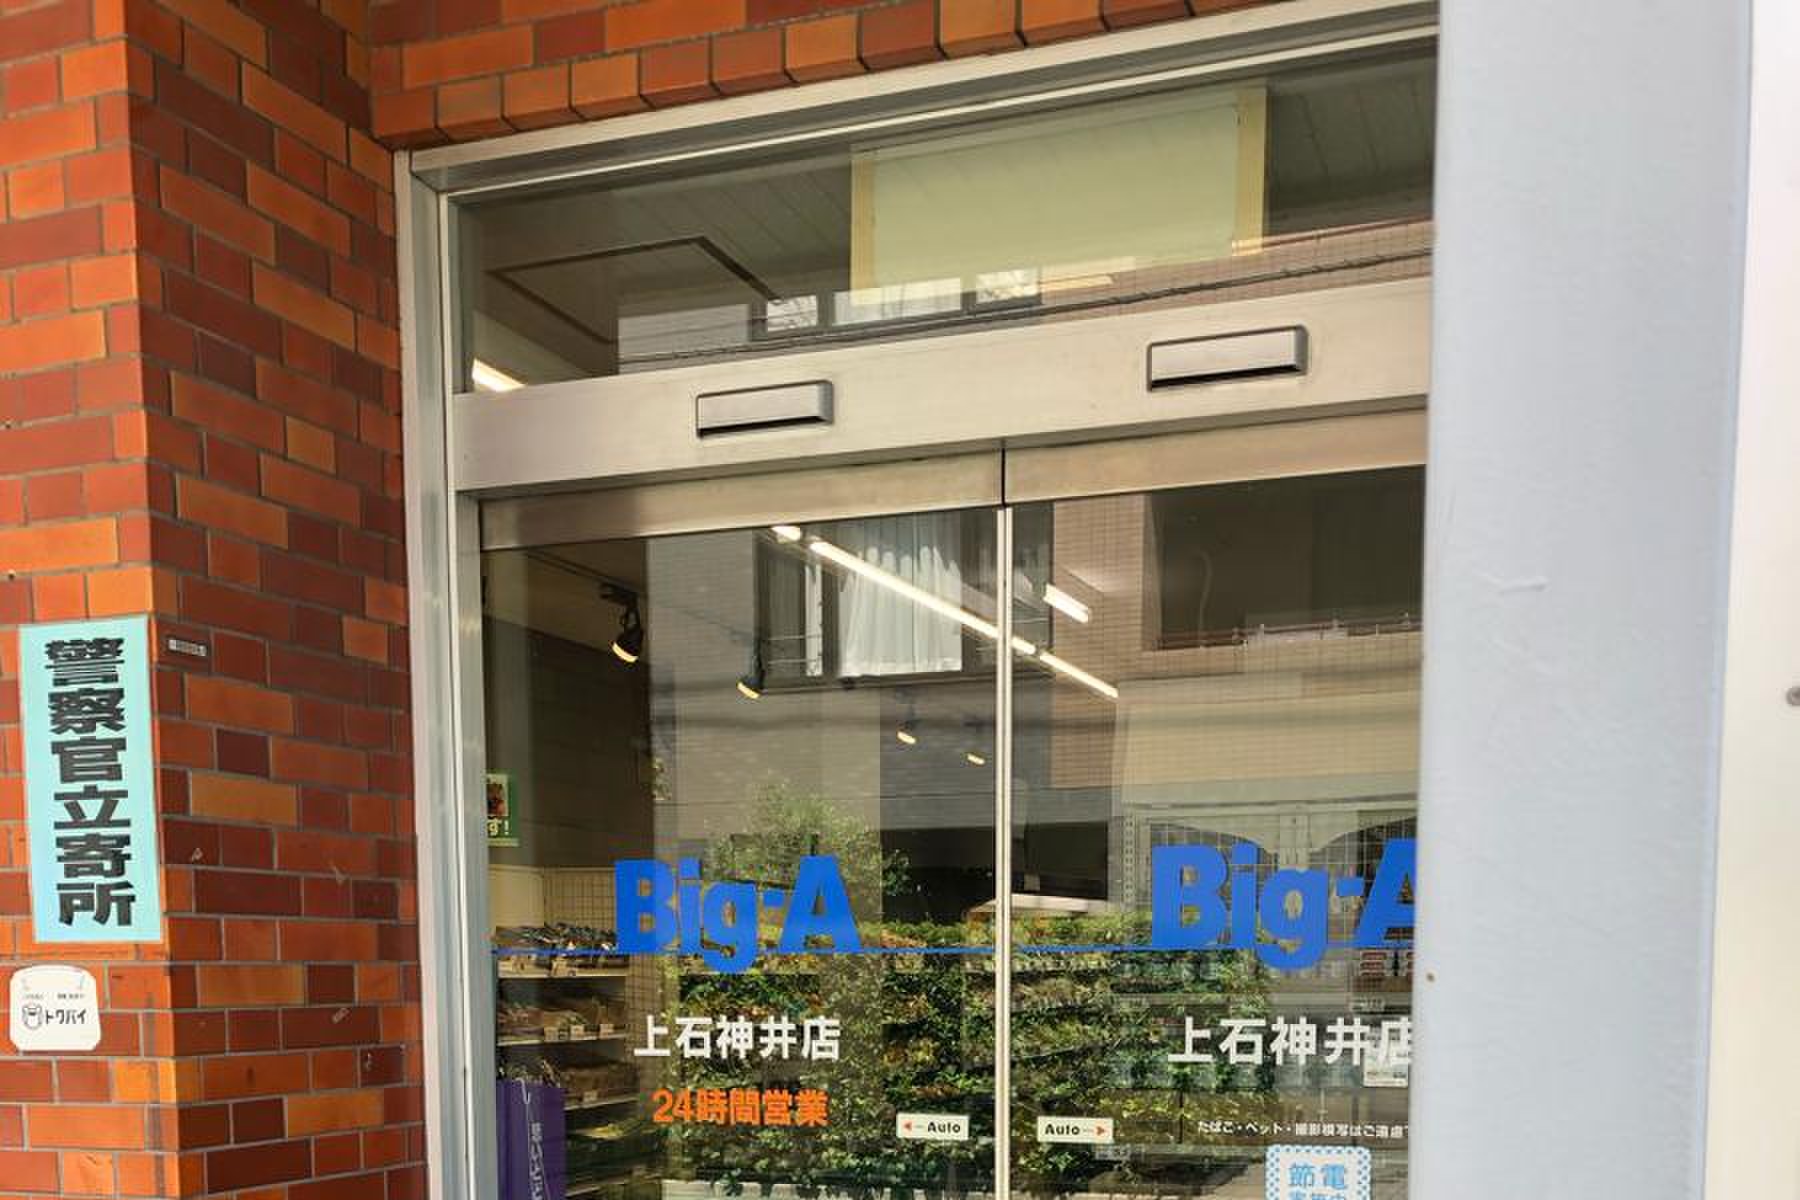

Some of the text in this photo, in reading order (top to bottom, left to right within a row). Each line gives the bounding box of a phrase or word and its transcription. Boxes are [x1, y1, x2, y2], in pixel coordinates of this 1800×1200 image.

[45, 637, 136, 927] 警察官立寄所
[614, 854, 863, 973] Big-A
[634, 1015, 840, 1061] 上石神井店
[652, 1088, 829, 1127] 24時間営業
[926, 1120, 962, 1134] Auto
[1044, 1123, 1081, 1136] Auto
[1288, 1162, 1347, 1190] 節電
